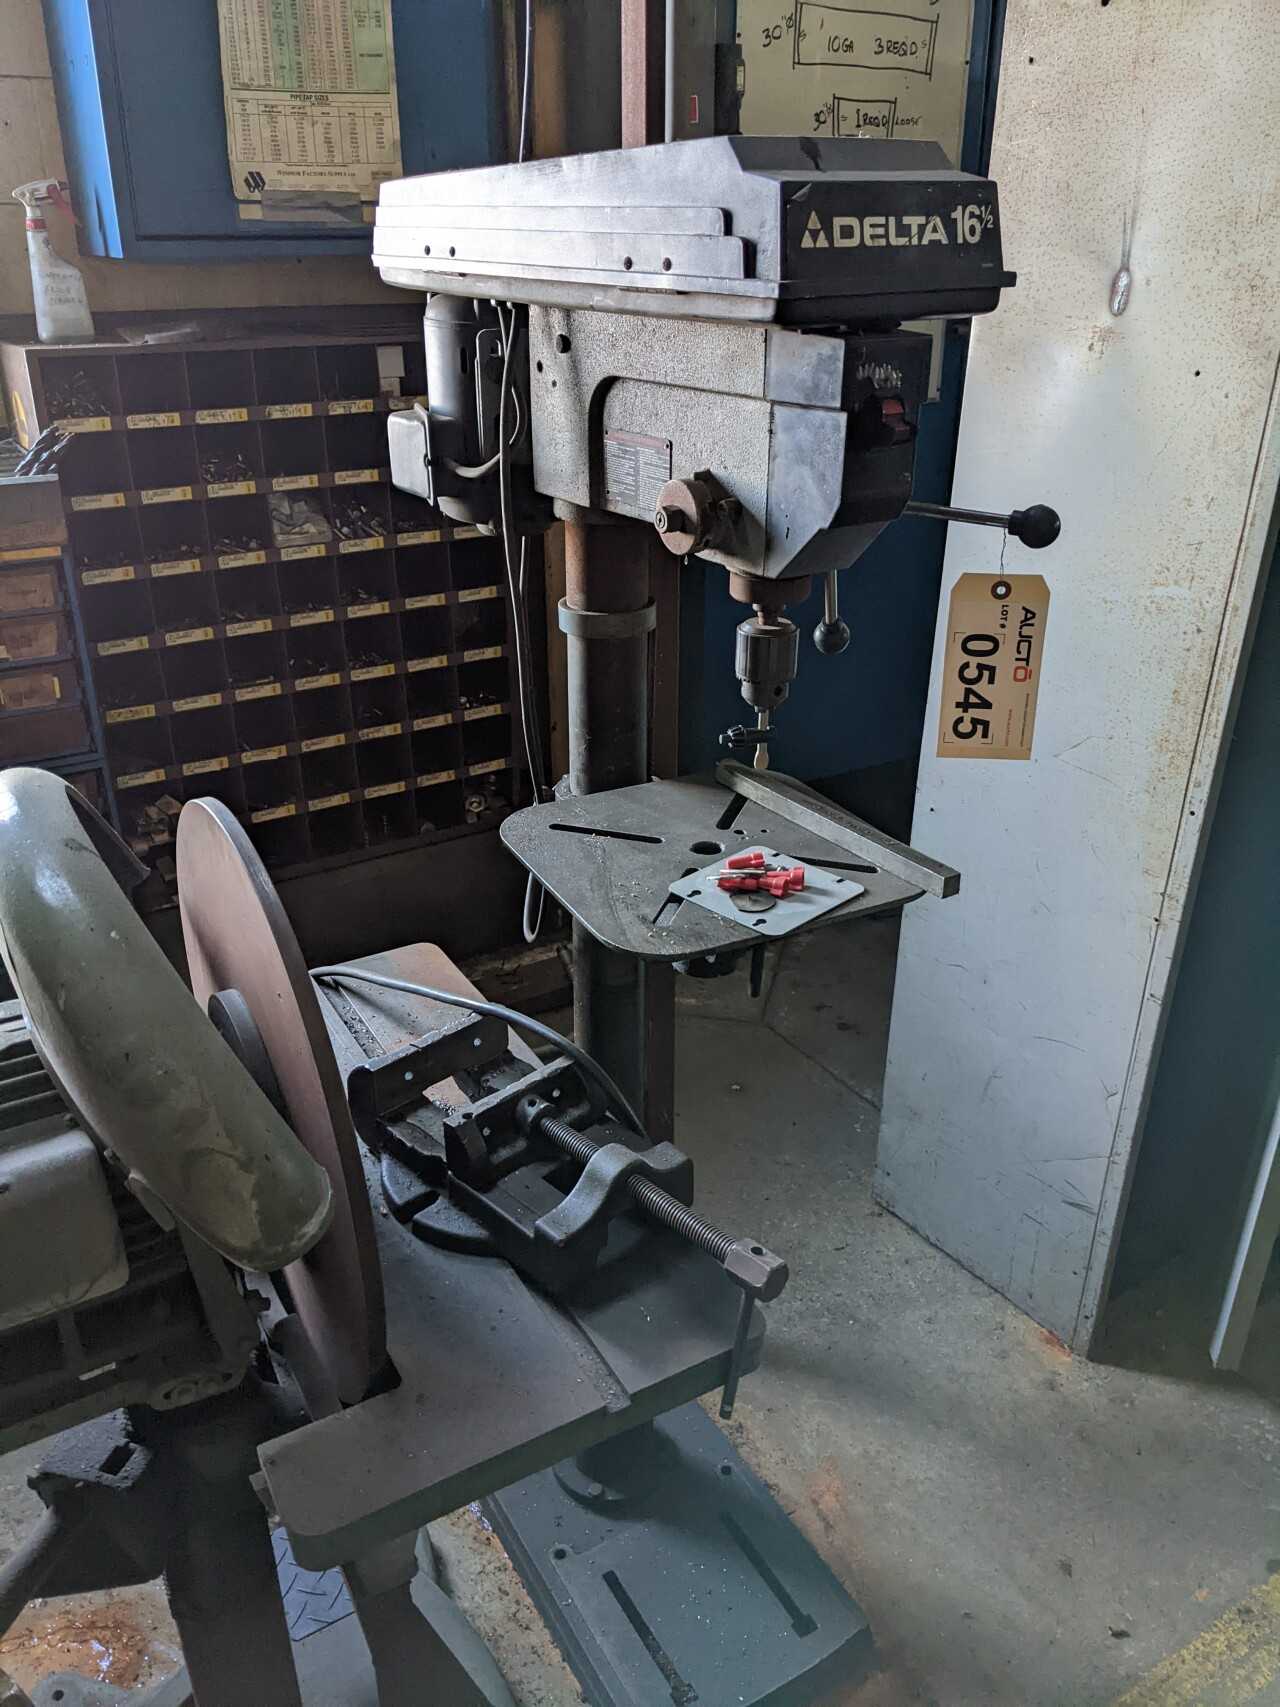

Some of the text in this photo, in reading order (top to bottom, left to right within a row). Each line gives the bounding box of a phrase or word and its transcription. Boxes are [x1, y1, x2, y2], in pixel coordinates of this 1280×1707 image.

[832, 215, 949, 248] DELTA
[1000, 605, 1011, 623] LOT
[952, 633, 1000, 740] 0545
